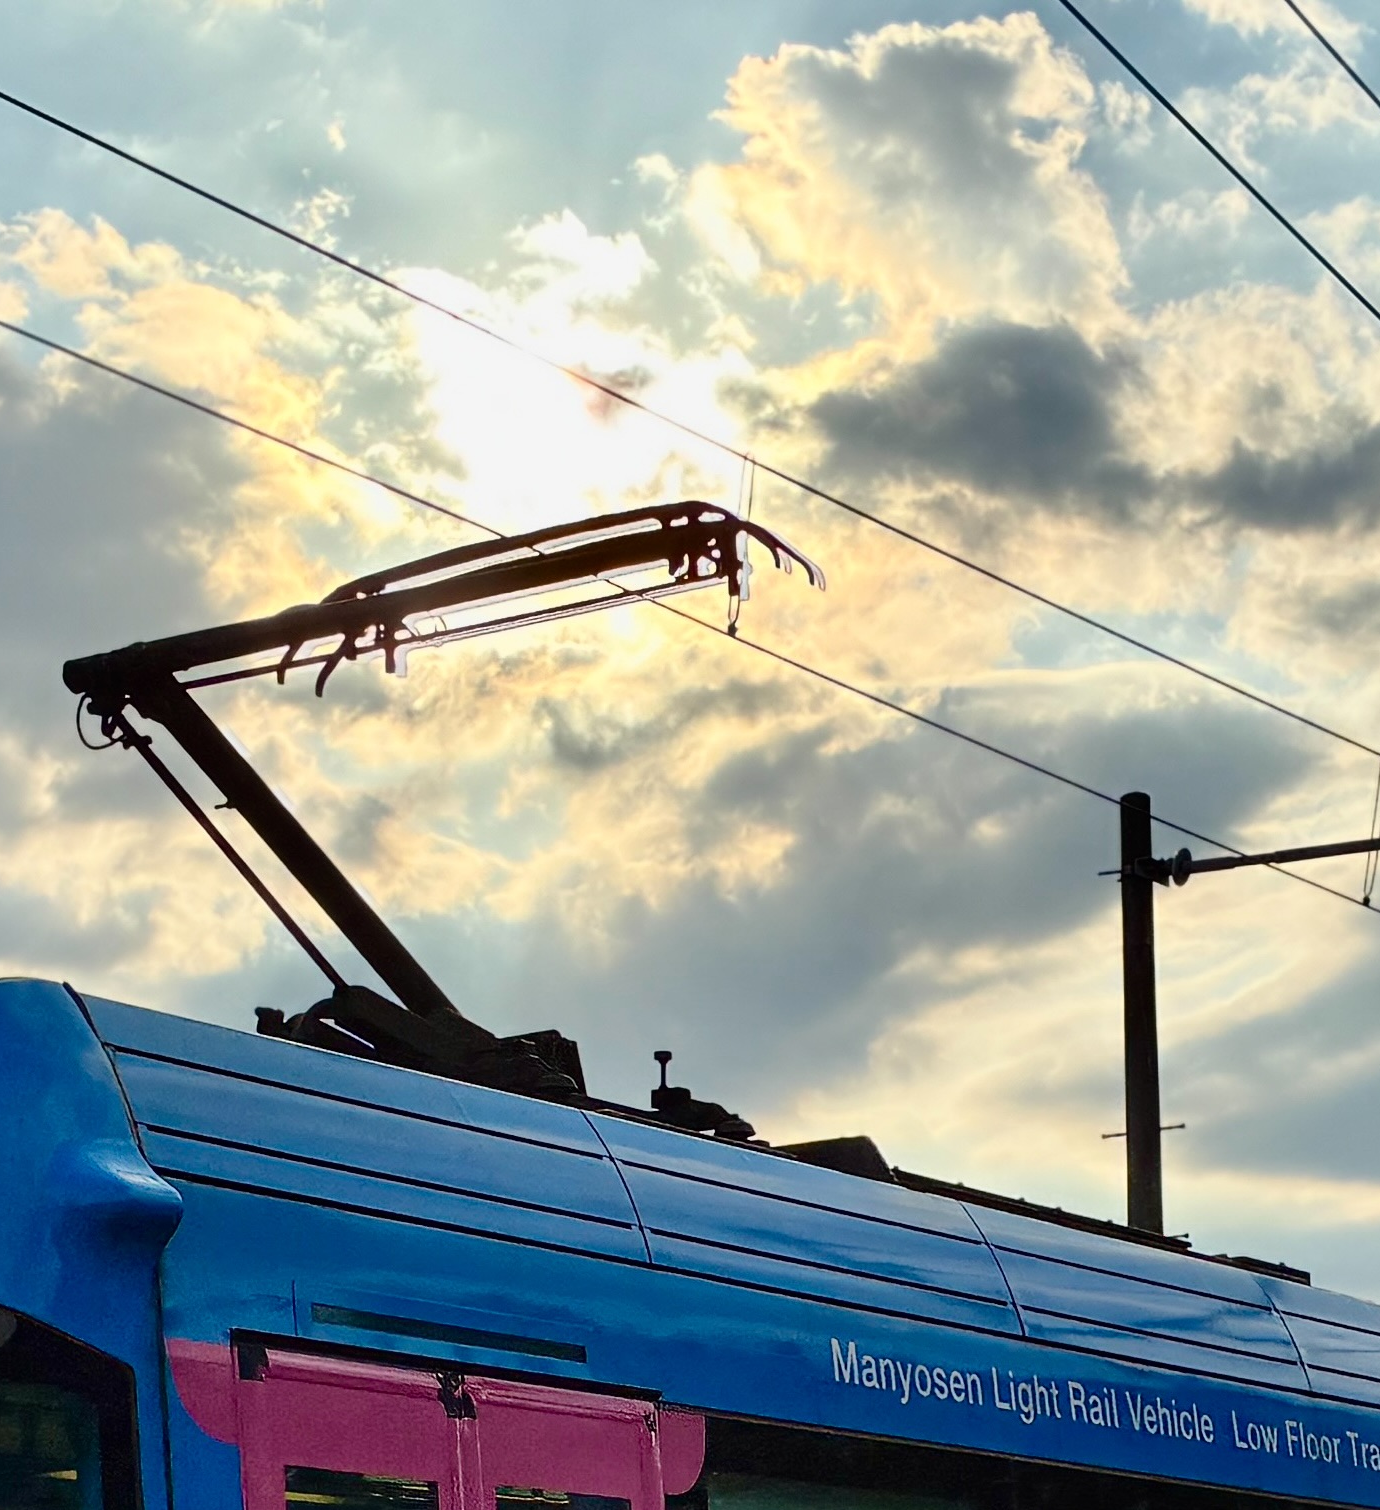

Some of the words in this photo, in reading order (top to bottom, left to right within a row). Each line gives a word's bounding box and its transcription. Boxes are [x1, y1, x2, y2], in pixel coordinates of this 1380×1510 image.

[830, 1338, 983, 1405] Manyosen
[991, 1367, 1062, 1424] Light
[1067, 1381, 1120, 1429] Rail
[1125, 1391, 1215, 1443] Vehicle
[1231, 1410, 1279, 1453] Low
[1285, 1419, 1342, 1463] Floor
